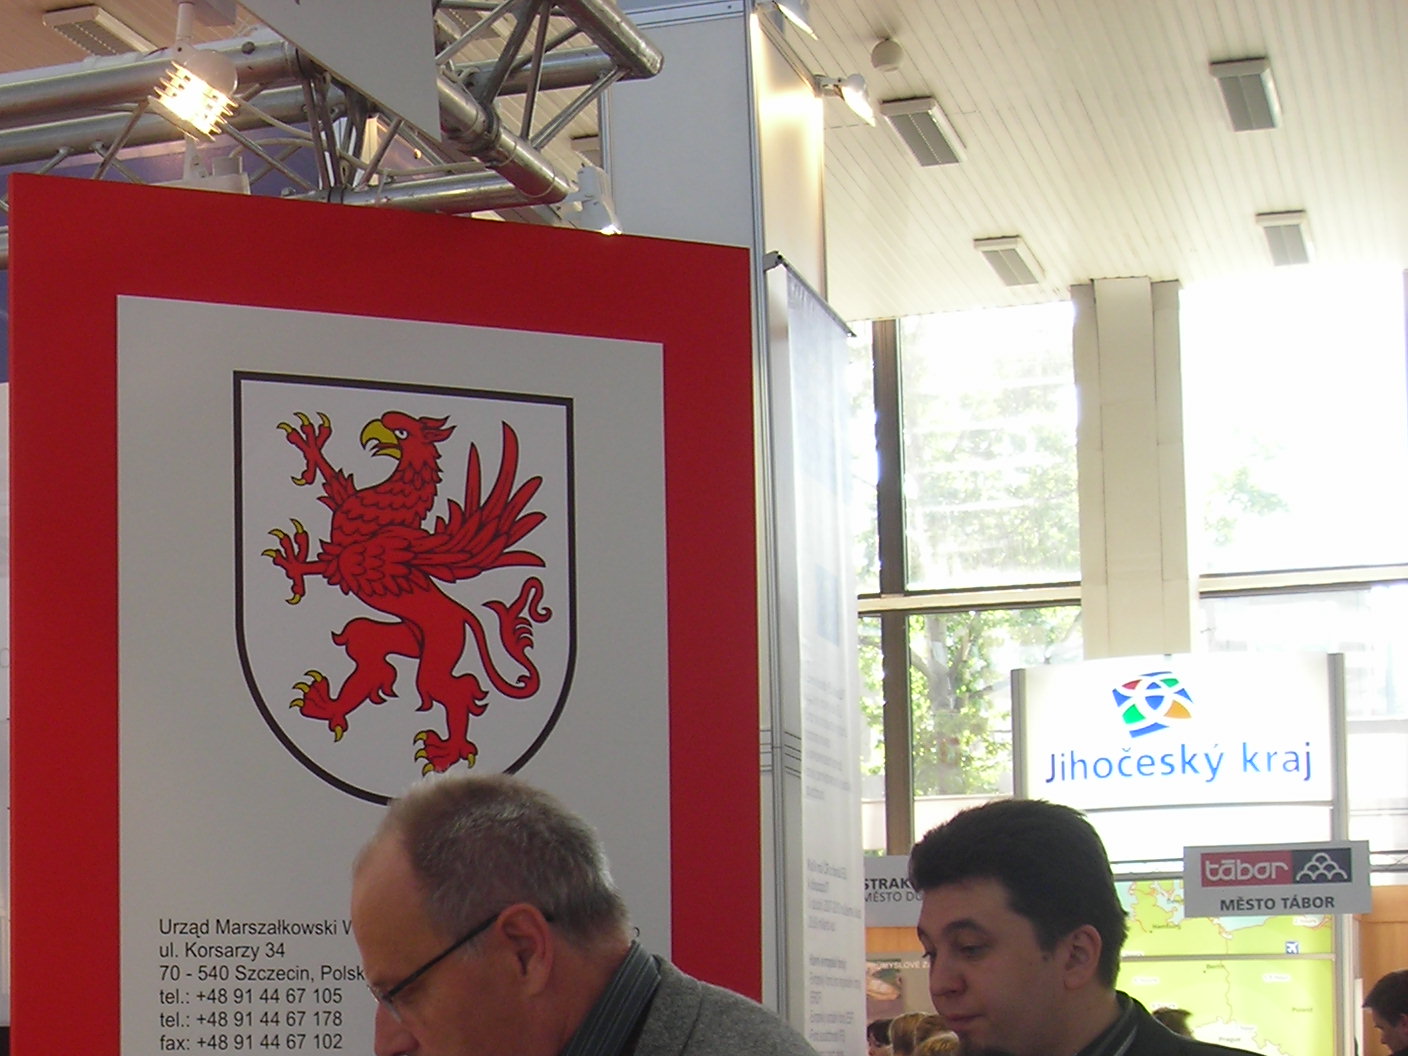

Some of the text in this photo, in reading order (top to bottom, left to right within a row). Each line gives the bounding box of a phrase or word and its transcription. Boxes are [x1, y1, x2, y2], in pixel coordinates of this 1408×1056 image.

[1045, 741, 1313, 783] Jihočeský kraj
[1220, 895, 1336, 912] MĚSTO TÁBOR
[159, 919, 209, 938] Urząd
[215, 919, 337, 935] Marszałkowski
[159, 942, 285, 961] ul. Korsarzy 34
[159, 965, 180, 981] 70
[198, 965, 229, 981] 540
[235, 964, 314, 983] Szczecin,
[321, 965, 365, 981] Polsk
[160, 989, 342, 1005] tel.: +48 91 44 67 105
[160, 1011, 342, 1027] tel.: +48 91 44 67 178
[160, 1034, 342, 1050] fax: +48 91 44 67 102
